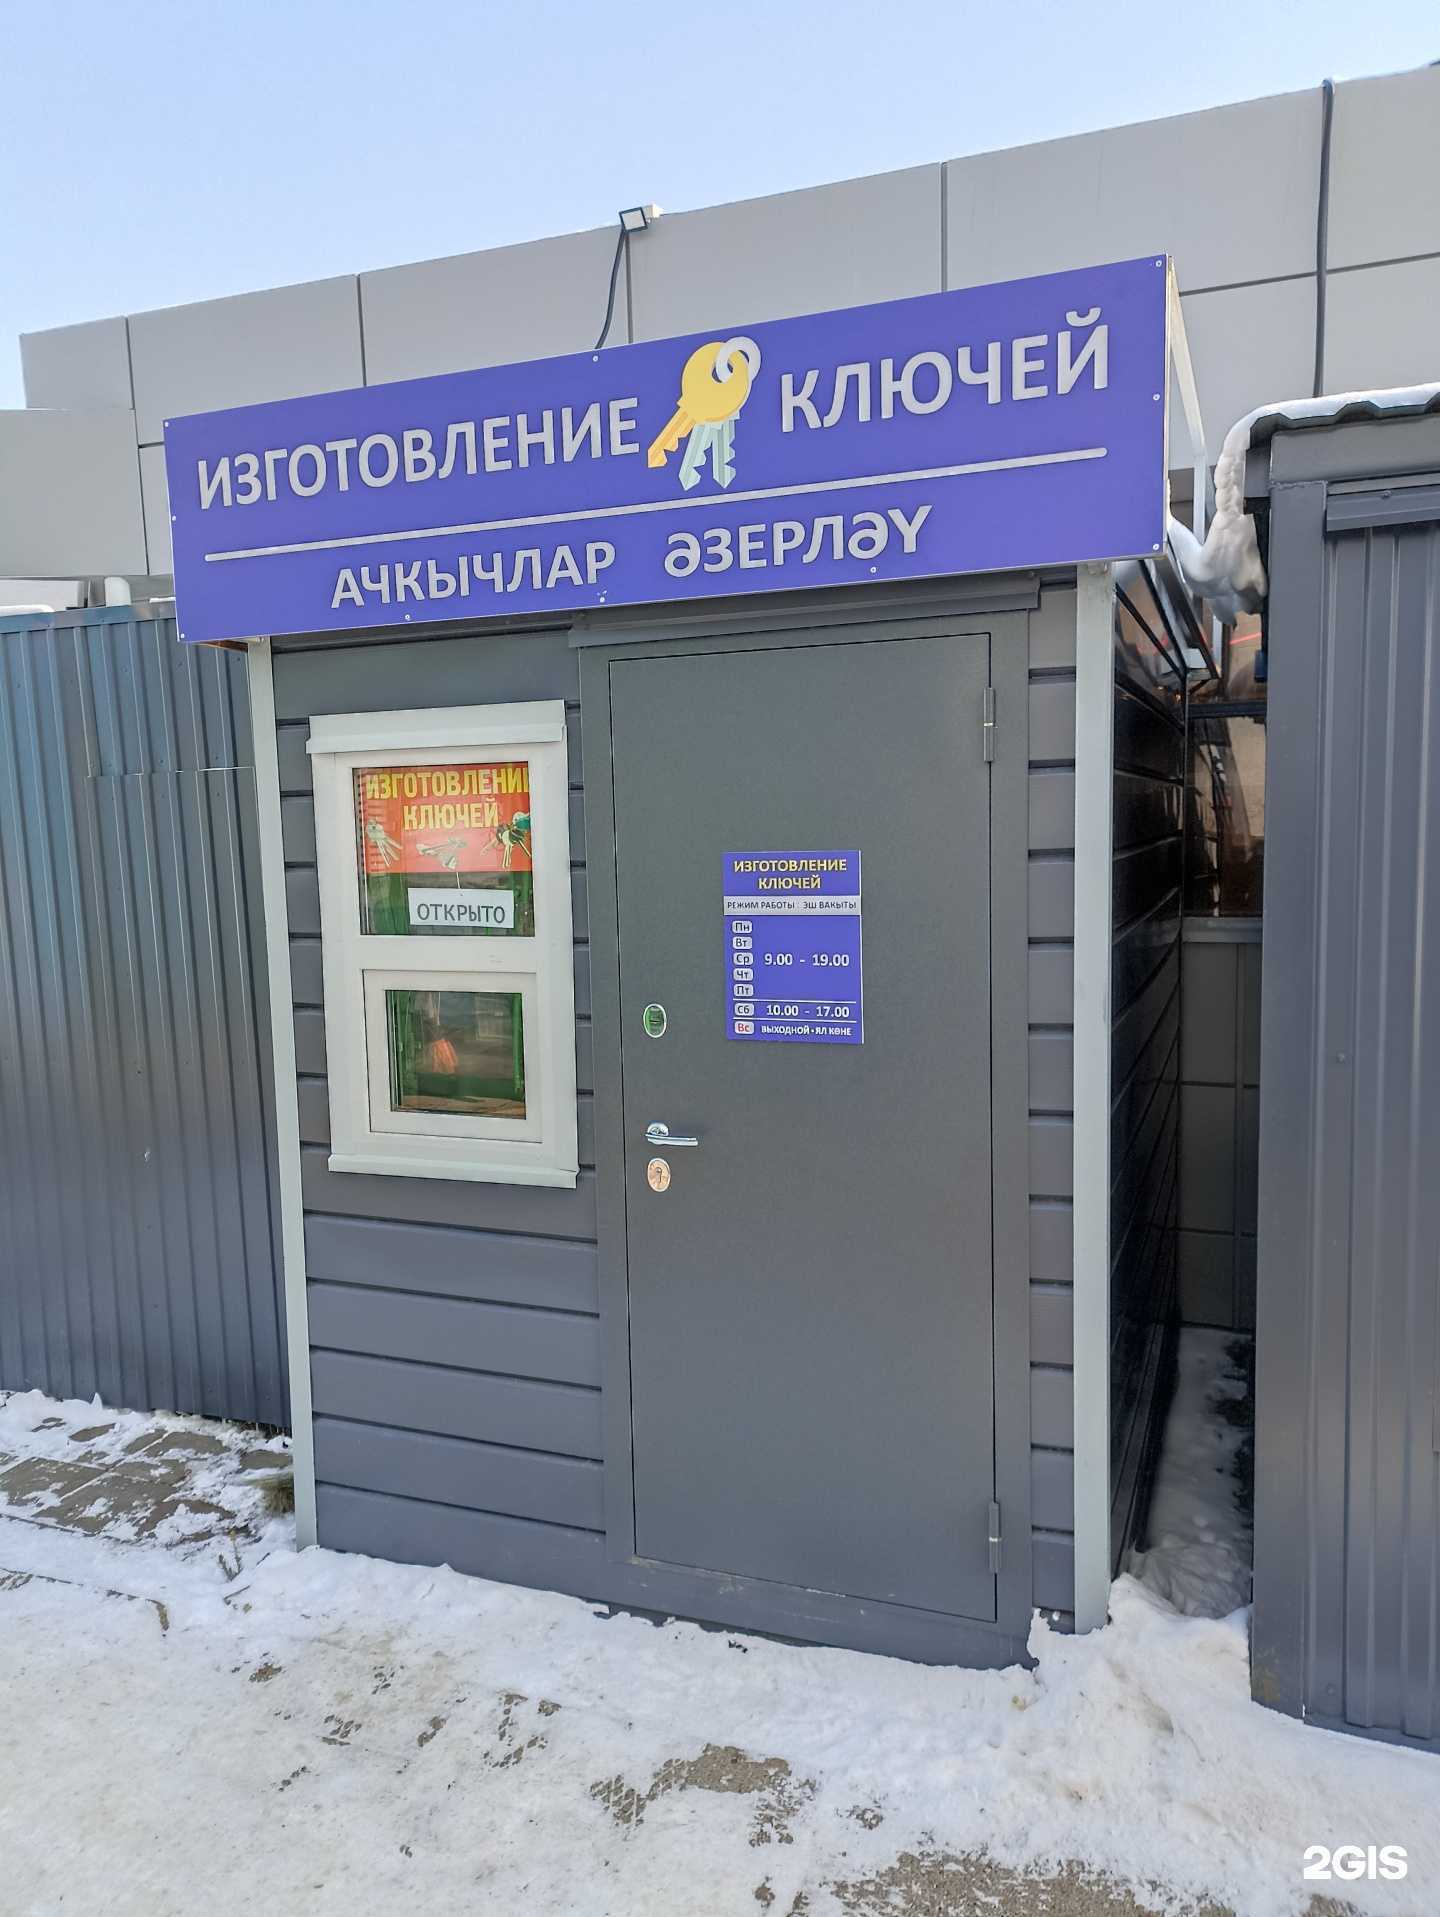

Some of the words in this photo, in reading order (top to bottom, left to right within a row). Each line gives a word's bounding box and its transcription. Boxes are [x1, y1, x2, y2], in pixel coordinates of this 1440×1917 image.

[198, 397, 640, 510] ИЗГОТОВЛЕНИЕ
[781, 307, 1109, 433] КЛЮЧЕЙ
[331, 541, 616, 609] АЧКЫЧЛАР
[403, 797, 499, 831] КЛЮЧЕЙ
[734, 859, 847, 873] ИЗГОТОВЛЕНИЕ
[758, 875, 821, 890] КЛЮЧЕЙ
[727, 901, 759, 909] РЕЖИМ
[761, 901, 795, 909] РАБОТЫ
[819, 901, 857, 909] ВАКЫТЫ
[417, 903, 506, 924] ОТКРЫТО
[735, 922, 750, 931] Пн
[735, 938, 747, 947] Вт
[736, 954, 750, 965] Ср
[764, 953, 793, 966] 9.00
[812, 954, 850, 967] 19.00
[736, 970, 749, 979] Чт
[737, 985, 749, 994] Пт
[737, 1004, 750, 1014] Сб
[766, 1005, 799, 1016] 10.00
[816, 1006, 850, 1018] 17.00
[737, 1023, 750, 1032] Вс
